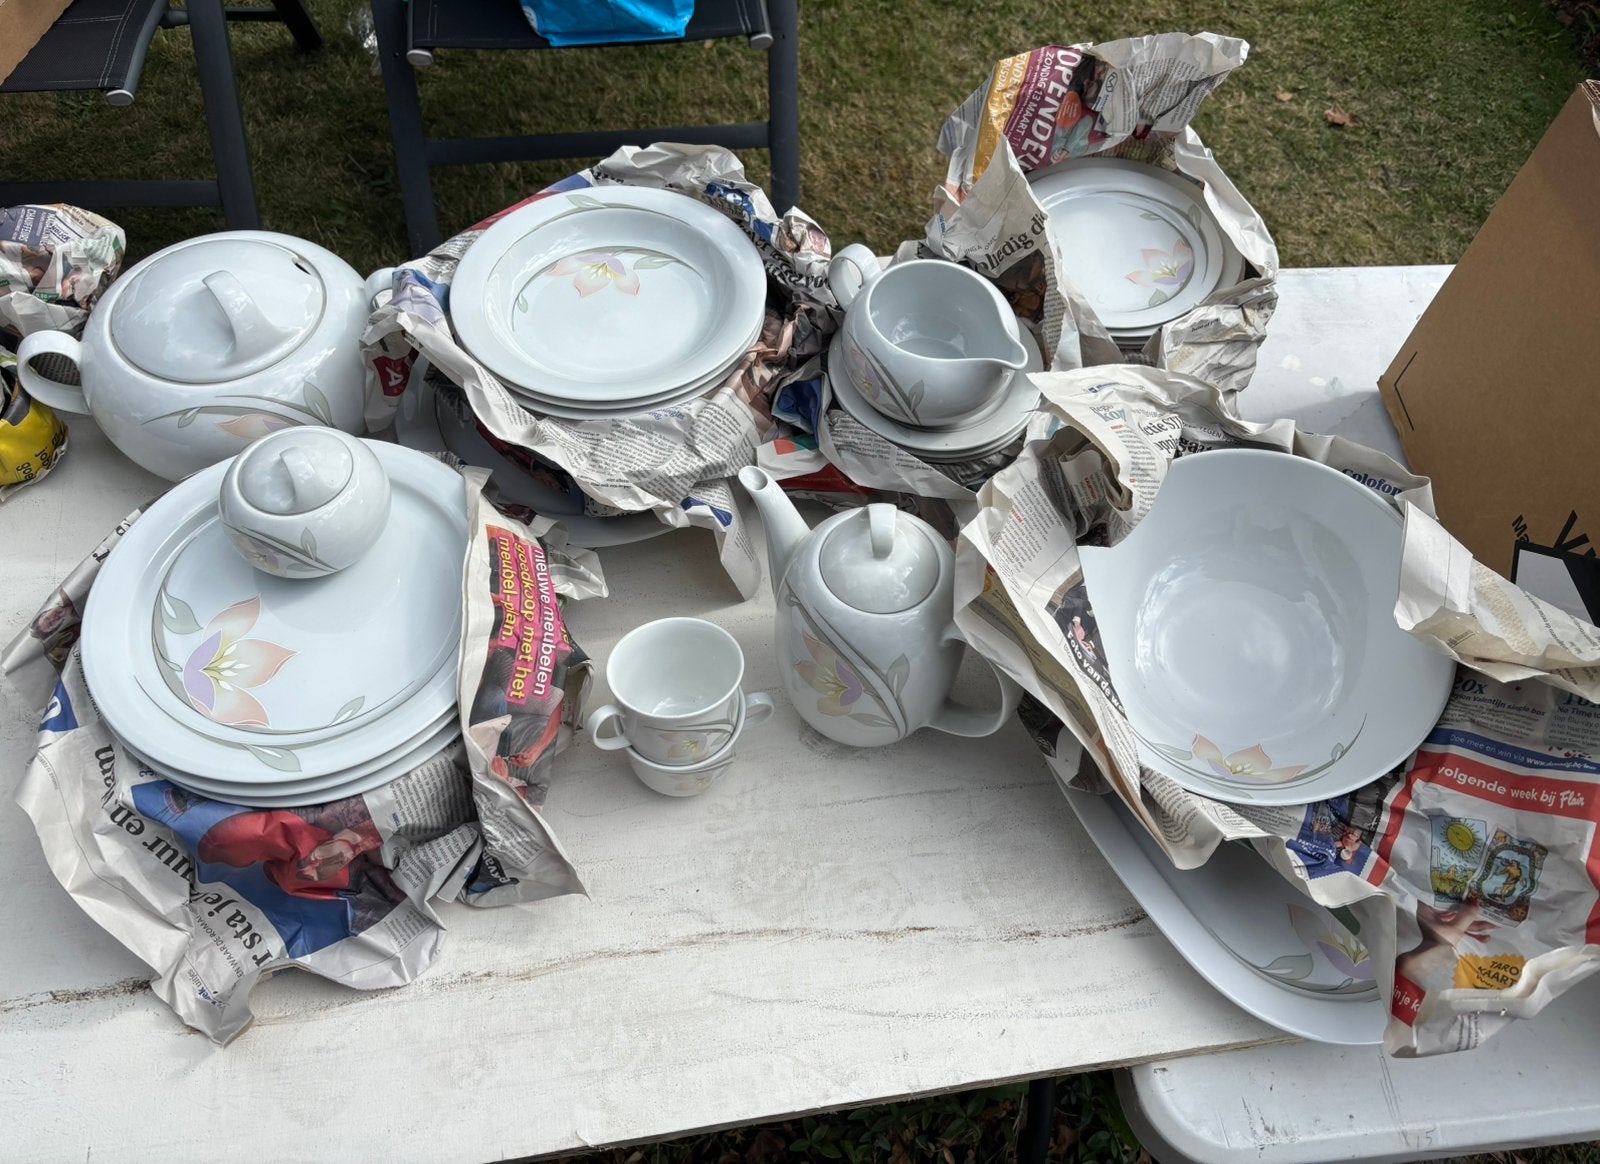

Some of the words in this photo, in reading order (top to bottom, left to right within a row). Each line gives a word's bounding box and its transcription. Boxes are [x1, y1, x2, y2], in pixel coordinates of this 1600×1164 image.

[1036, 51, 1054, 88] ZONDAG
[1031, 89, 1043, 100] 13
[1014, 101, 1035, 135] MAART
[24, 208, 36, 243] CHAUFFEURS
[498, 536, 519, 641] meubel-plan.
[515, 542, 535, 622] goedkoop
[534, 548, 551, 604] nieuwe
[520, 626, 535, 663] met
[534, 606, 554, 696] meubelen
[1066, 630, 1083, 659] Foto
[1082, 659, 1101, 681] van
[1099, 679, 1111, 696] de
[509, 670, 532, 699] het
[1473, 693, 1507, 708] Valentijn
[1450, 734, 1464, 743] Doe
[1466, 738, 1484, 750] mee
[1486, 744, 1497, 752] en
[1497, 748, 1512, 758] win
[1513, 753, 1525, 761] via
[1438, 765, 1507, 795] volgende
[1510, 788, 1537, 800] week
[1540, 792, 1557, 807] bij
[1559, 790, 1585, 808] Flair
[213, 935, 223, 946] DE
[221, 906, 264, 953] sta
[219, 945, 237, 968] WAAR
[1489, 960, 1520, 977] TARO
[185, 967, 202, 988] uitjes
[1401, 990, 1410, 1005] je
